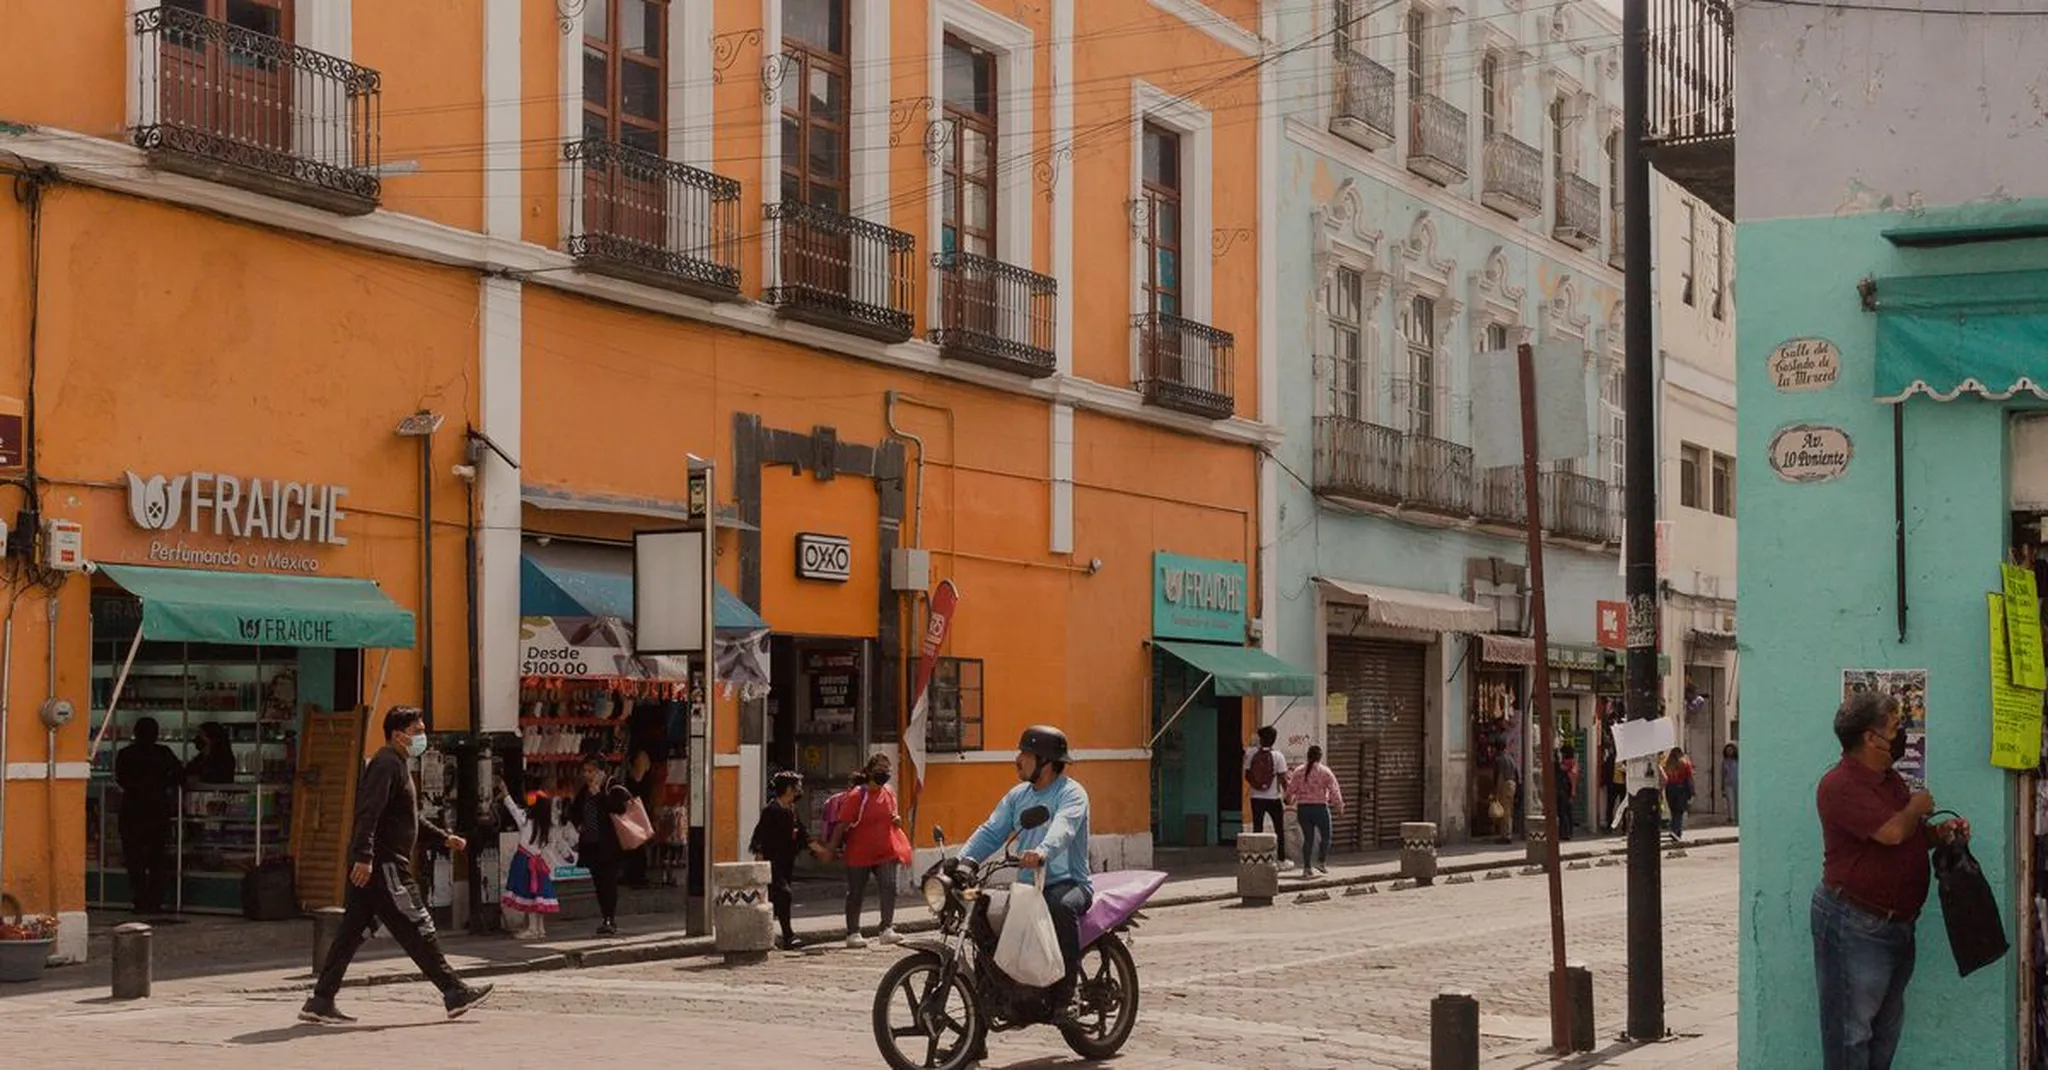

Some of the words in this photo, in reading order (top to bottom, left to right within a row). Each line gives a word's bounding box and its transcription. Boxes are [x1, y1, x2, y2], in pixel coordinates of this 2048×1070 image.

[1781, 343, 1809, 359] Calle
[1814, 342, 1829, 354] del
[1773, 357, 1815, 373] Costado
[1818, 355, 1830, 367] de
[1795, 366, 1837, 385] Merced
[1802, 433, 1824, 449] Av.
[1782, 451, 1797, 468] 10
[1798, 450, 1845, 467] Poniente
[190, 471, 348, 545] FRAICHE
[150, 541, 240, 566] Perfumando
[805, 544, 848, 571] OXXO
[264, 618, 333, 642] FRAICHE
[527, 647, 580, 660] Desde
[522, 660, 588, 676] $100.00
